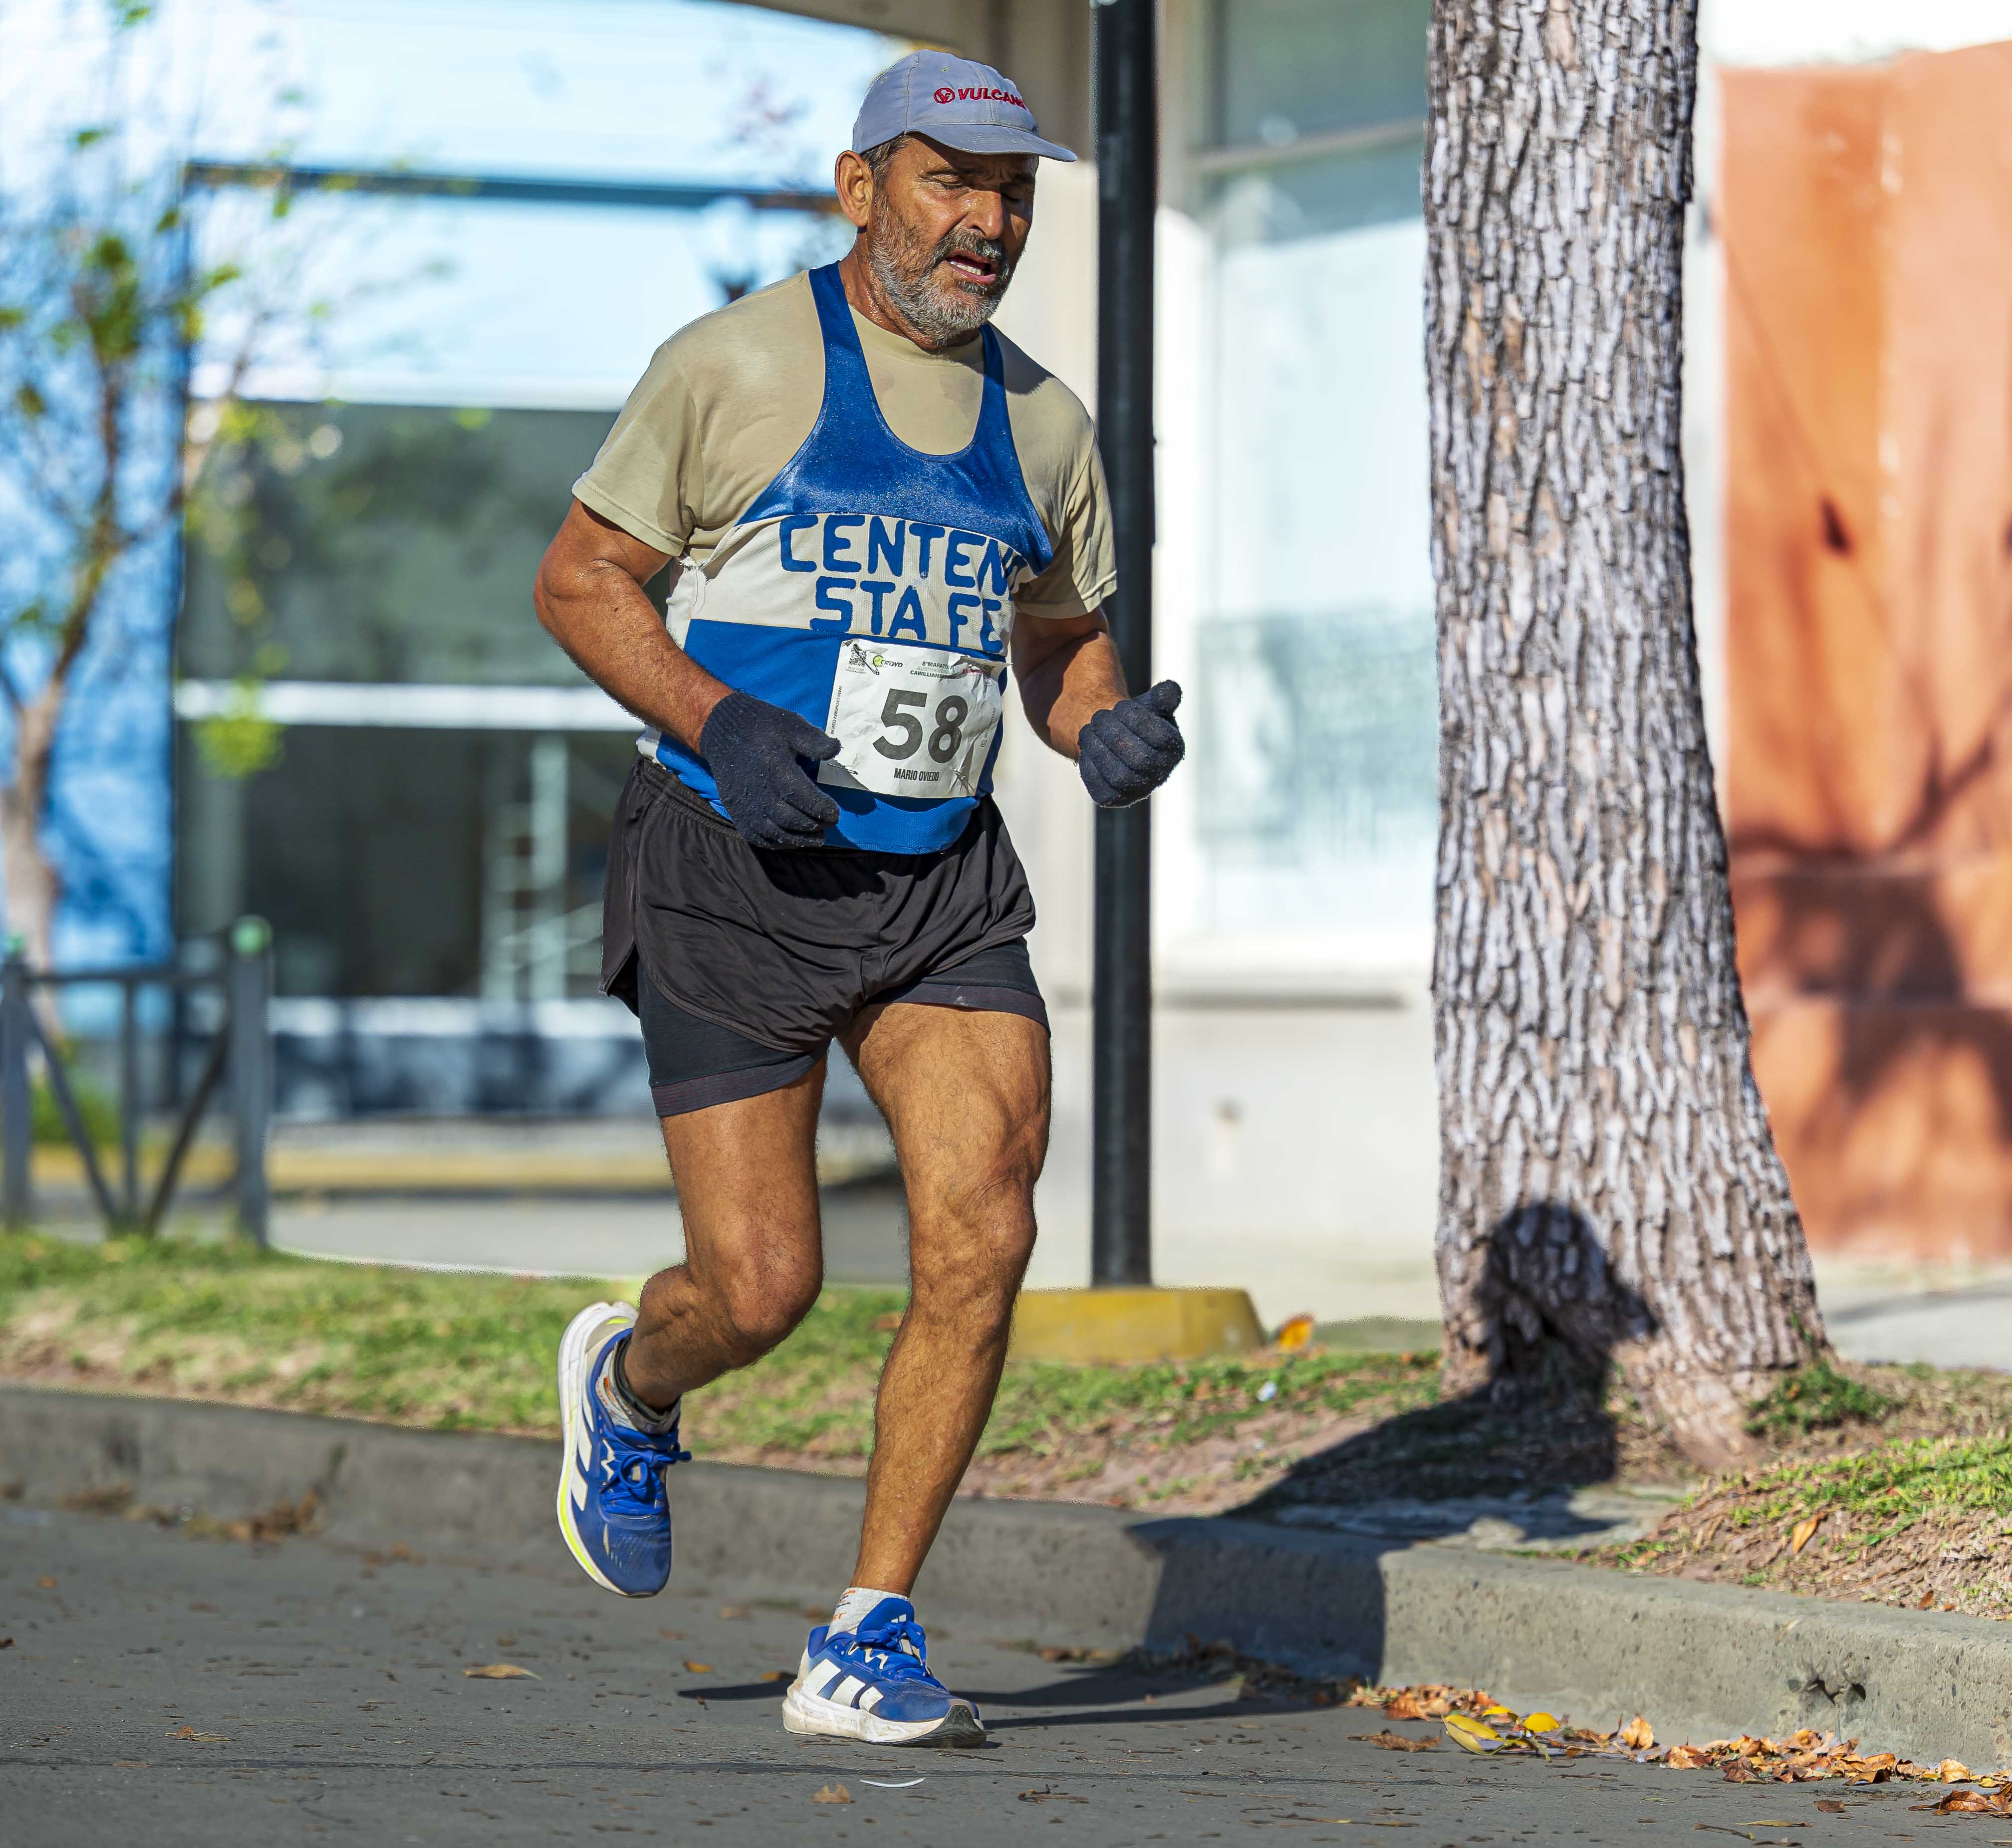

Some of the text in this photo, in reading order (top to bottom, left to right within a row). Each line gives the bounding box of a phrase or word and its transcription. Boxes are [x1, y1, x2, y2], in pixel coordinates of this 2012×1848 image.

[809, 576, 1004, 654] STA FE
[872, 688, 968, 764] 58
[894, 768, 940, 782] MARIO OVIEDO
